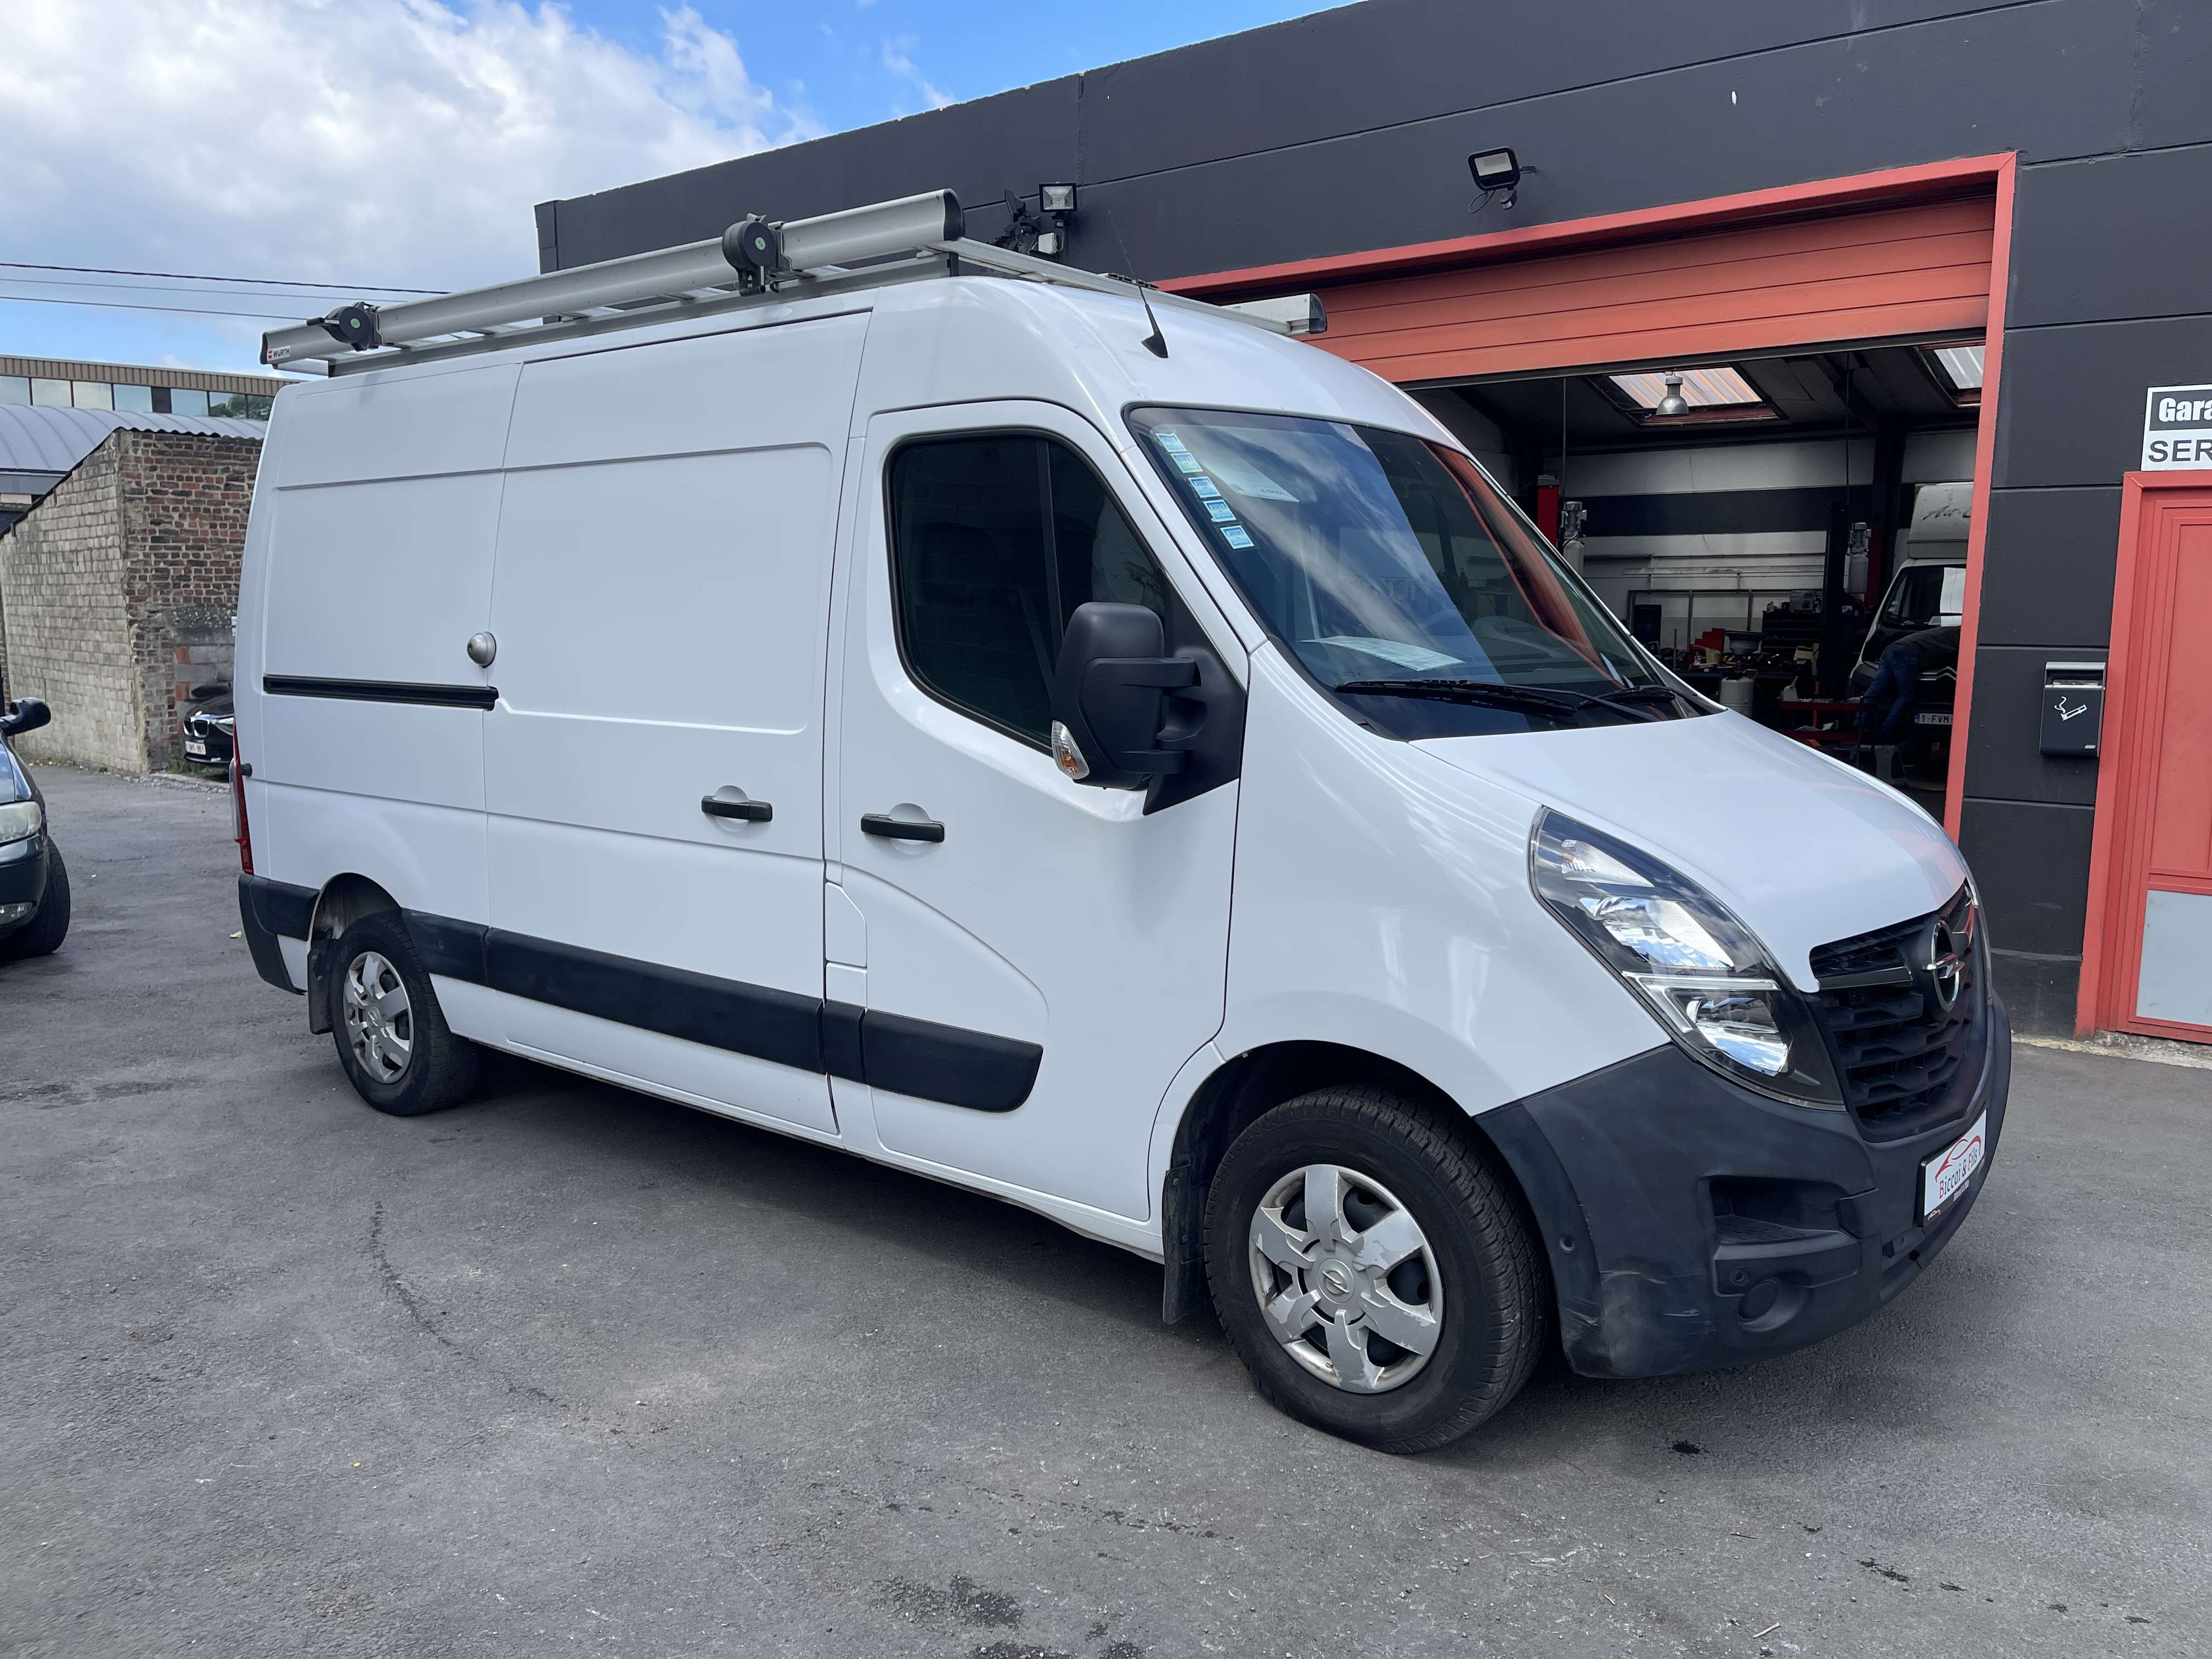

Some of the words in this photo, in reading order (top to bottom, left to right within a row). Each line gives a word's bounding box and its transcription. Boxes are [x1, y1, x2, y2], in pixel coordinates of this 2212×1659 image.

[2148, 439, 2212, 462] SER
[1962, 1159, 1967, 1177] &
[1968, 1147, 1977, 1171] Fils
